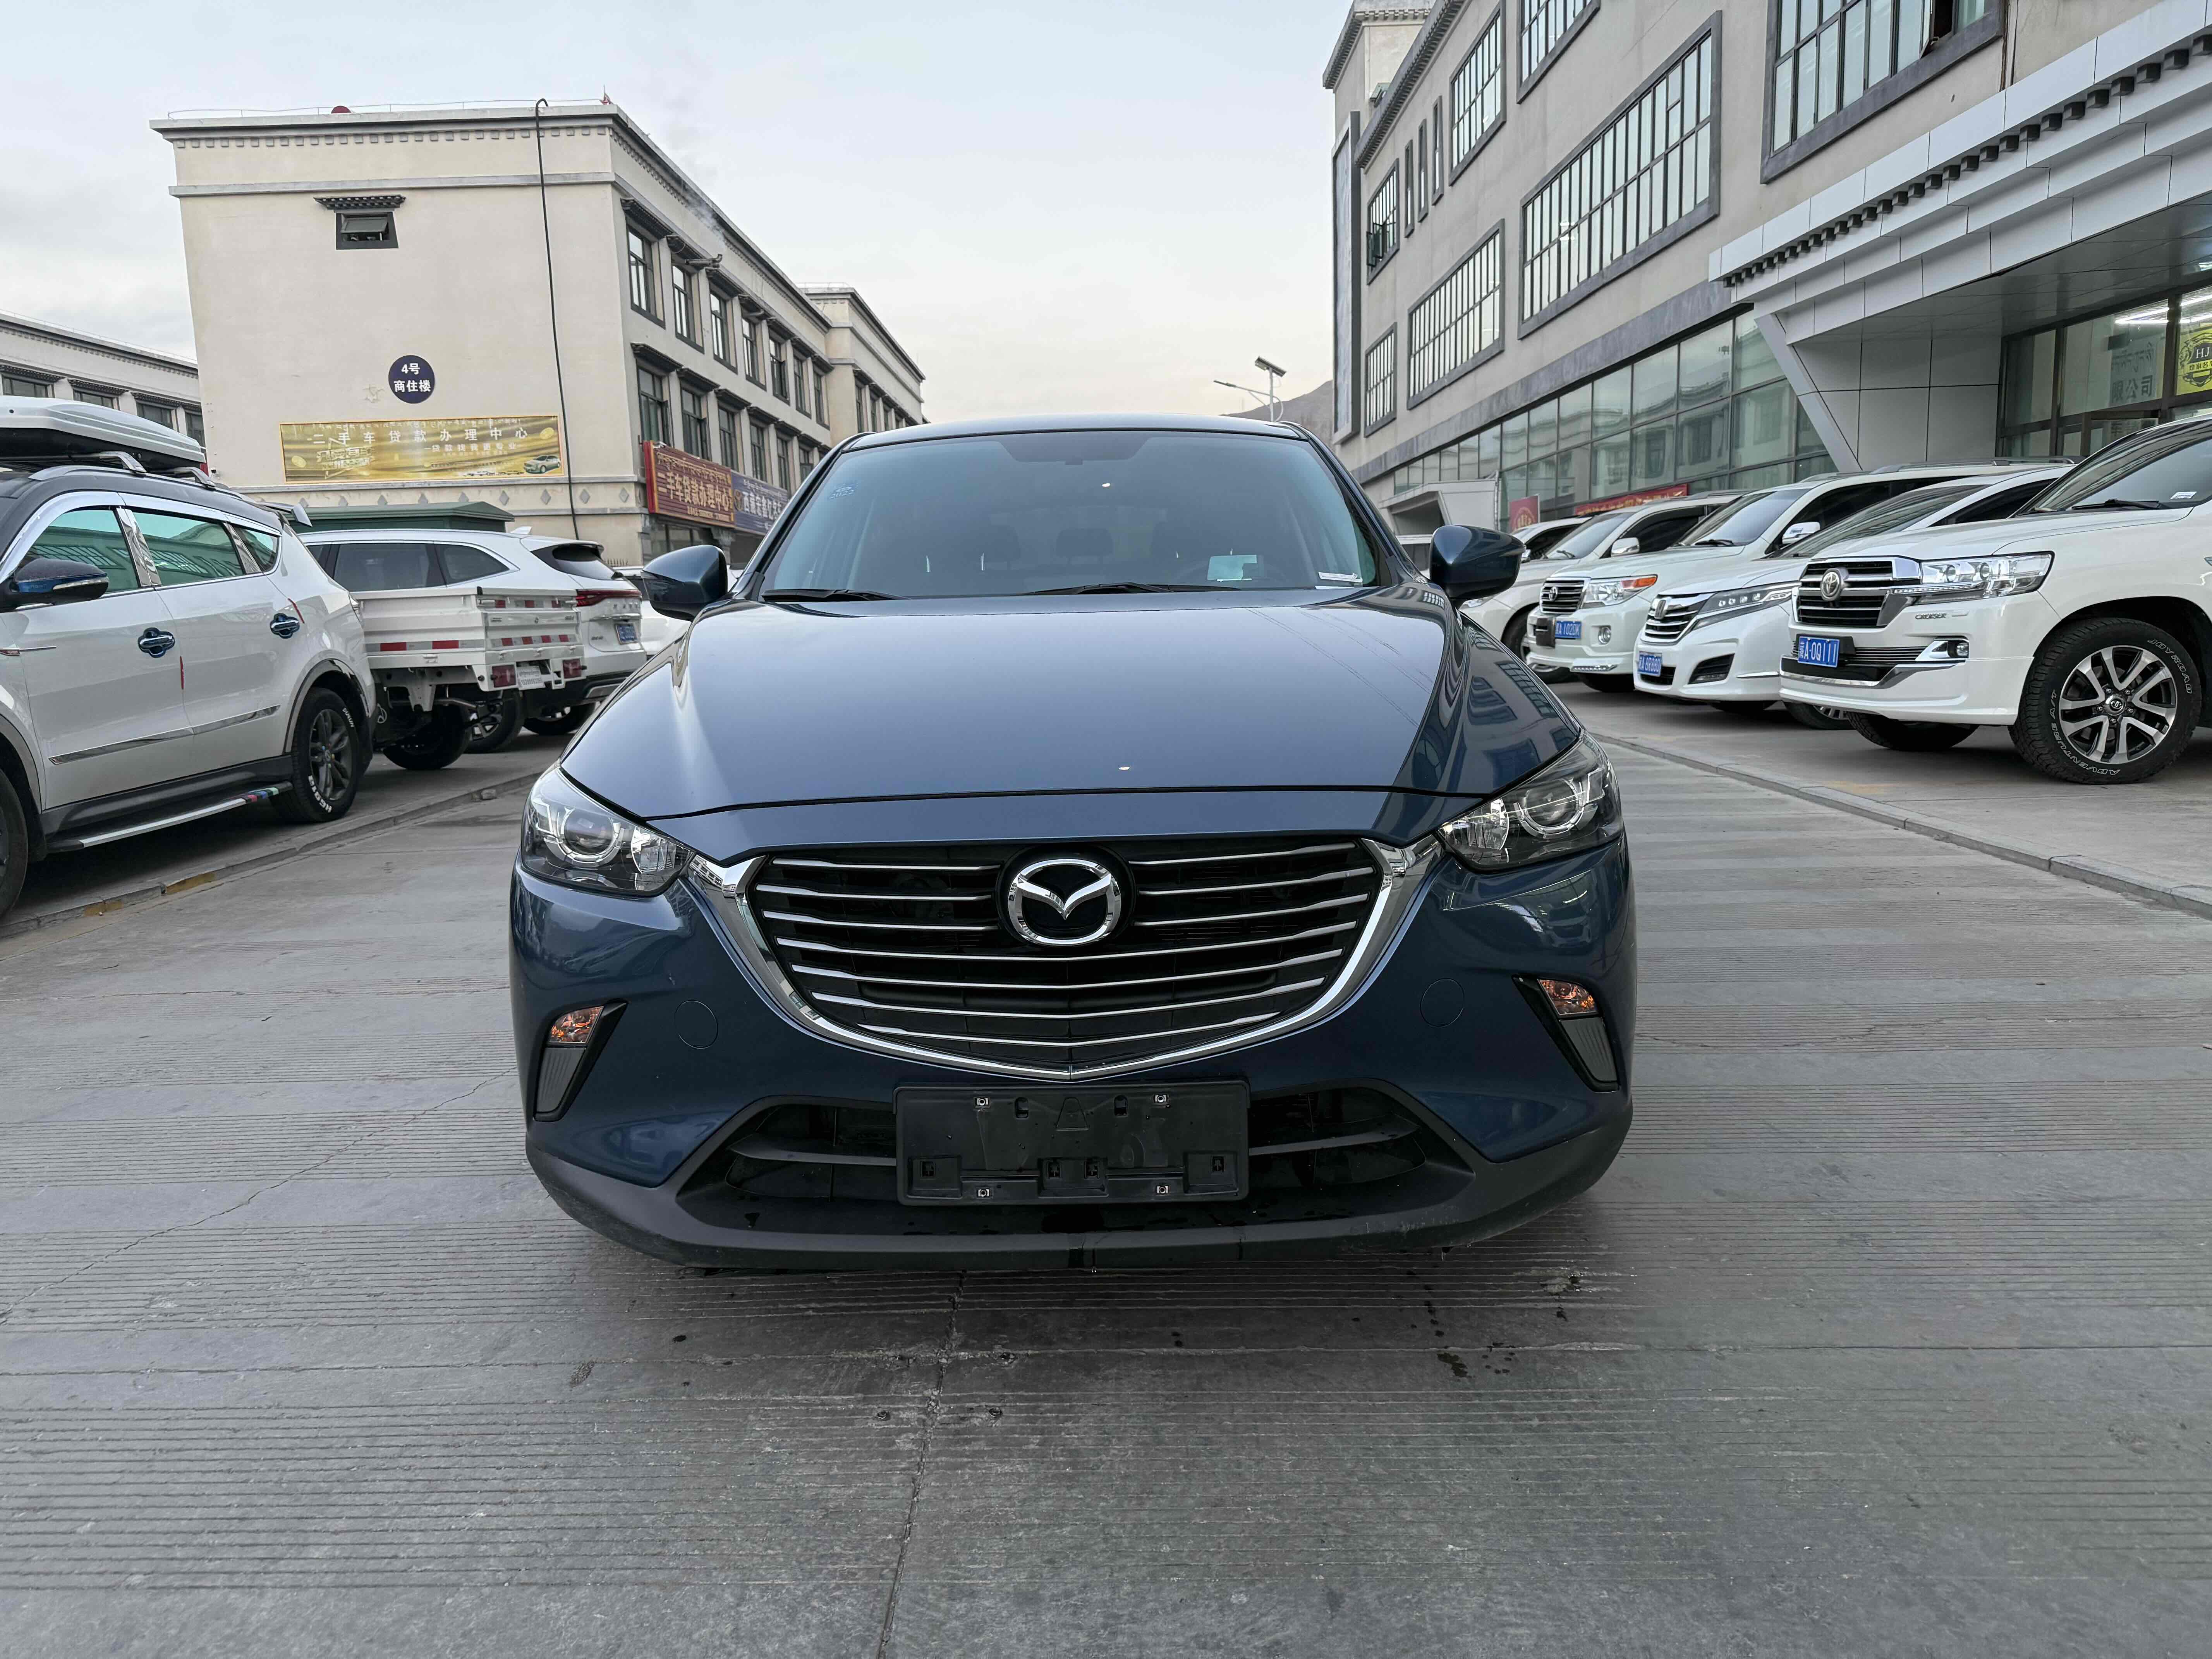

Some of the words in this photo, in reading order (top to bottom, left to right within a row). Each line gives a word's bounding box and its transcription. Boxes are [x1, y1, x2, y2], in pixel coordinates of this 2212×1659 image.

[401, 362, 421, 375] 4号
[393, 379, 431, 393] 商住楼
[313, 427, 528, 444] 二手车贷款办理中心
[657, 471, 729, 512] 二手车贷款办理中心
[2147, 639, 2193, 694] JOYROAD
[2051, 723, 2121, 775] ADVENTURE
